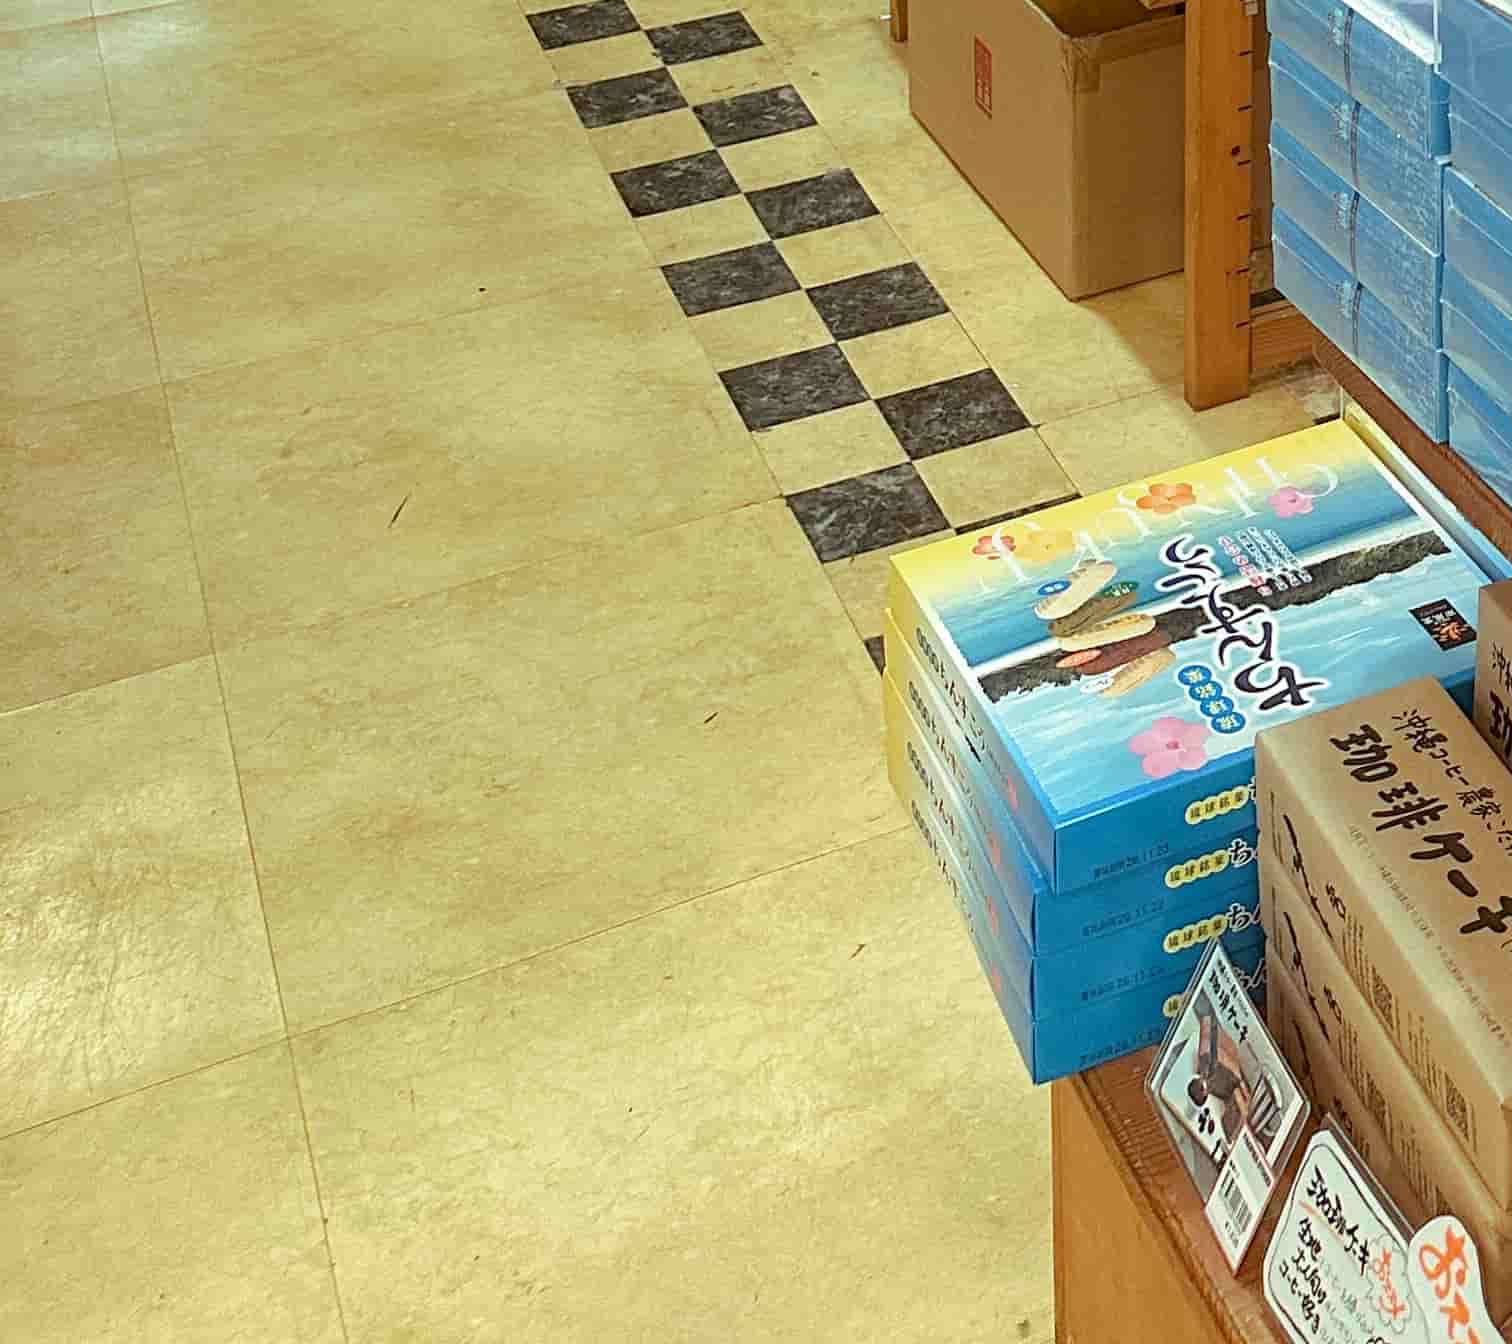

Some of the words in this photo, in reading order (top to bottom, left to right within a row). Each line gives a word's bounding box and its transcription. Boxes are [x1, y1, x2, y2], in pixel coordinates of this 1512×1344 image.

[1166, 534, 1325, 712] ちんすこう
